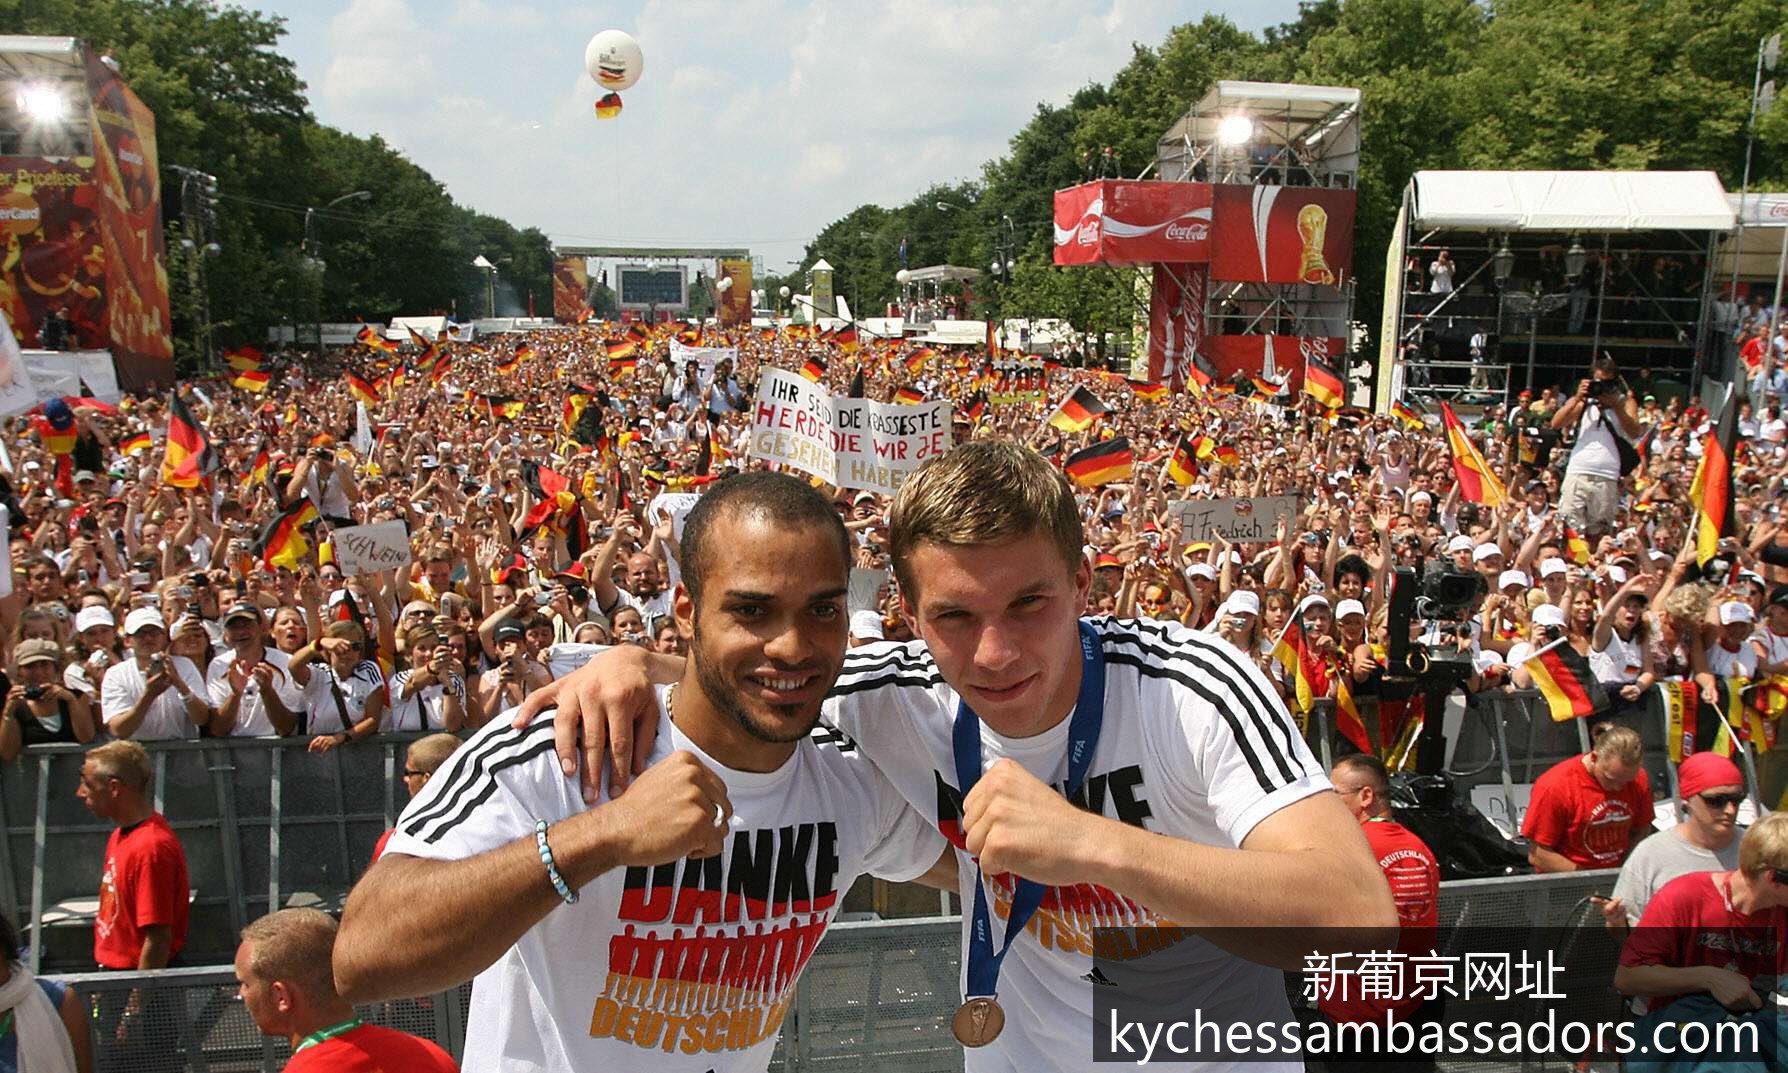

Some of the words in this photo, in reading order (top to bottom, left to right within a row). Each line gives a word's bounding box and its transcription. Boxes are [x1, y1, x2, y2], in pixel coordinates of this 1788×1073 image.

[771, 378, 799, 403] IHR
[808, 393, 832, 425] SEID
[838, 407, 862, 429] DIE
[829, 430, 862, 452] DIE
[873, 438, 908, 460] WIR
[916, 431, 945, 459] JE
[851, 459, 909, 489] HABE
[1082, 634, 1095, 660] FIFA
[1072, 740, 1086, 764] FIFA
